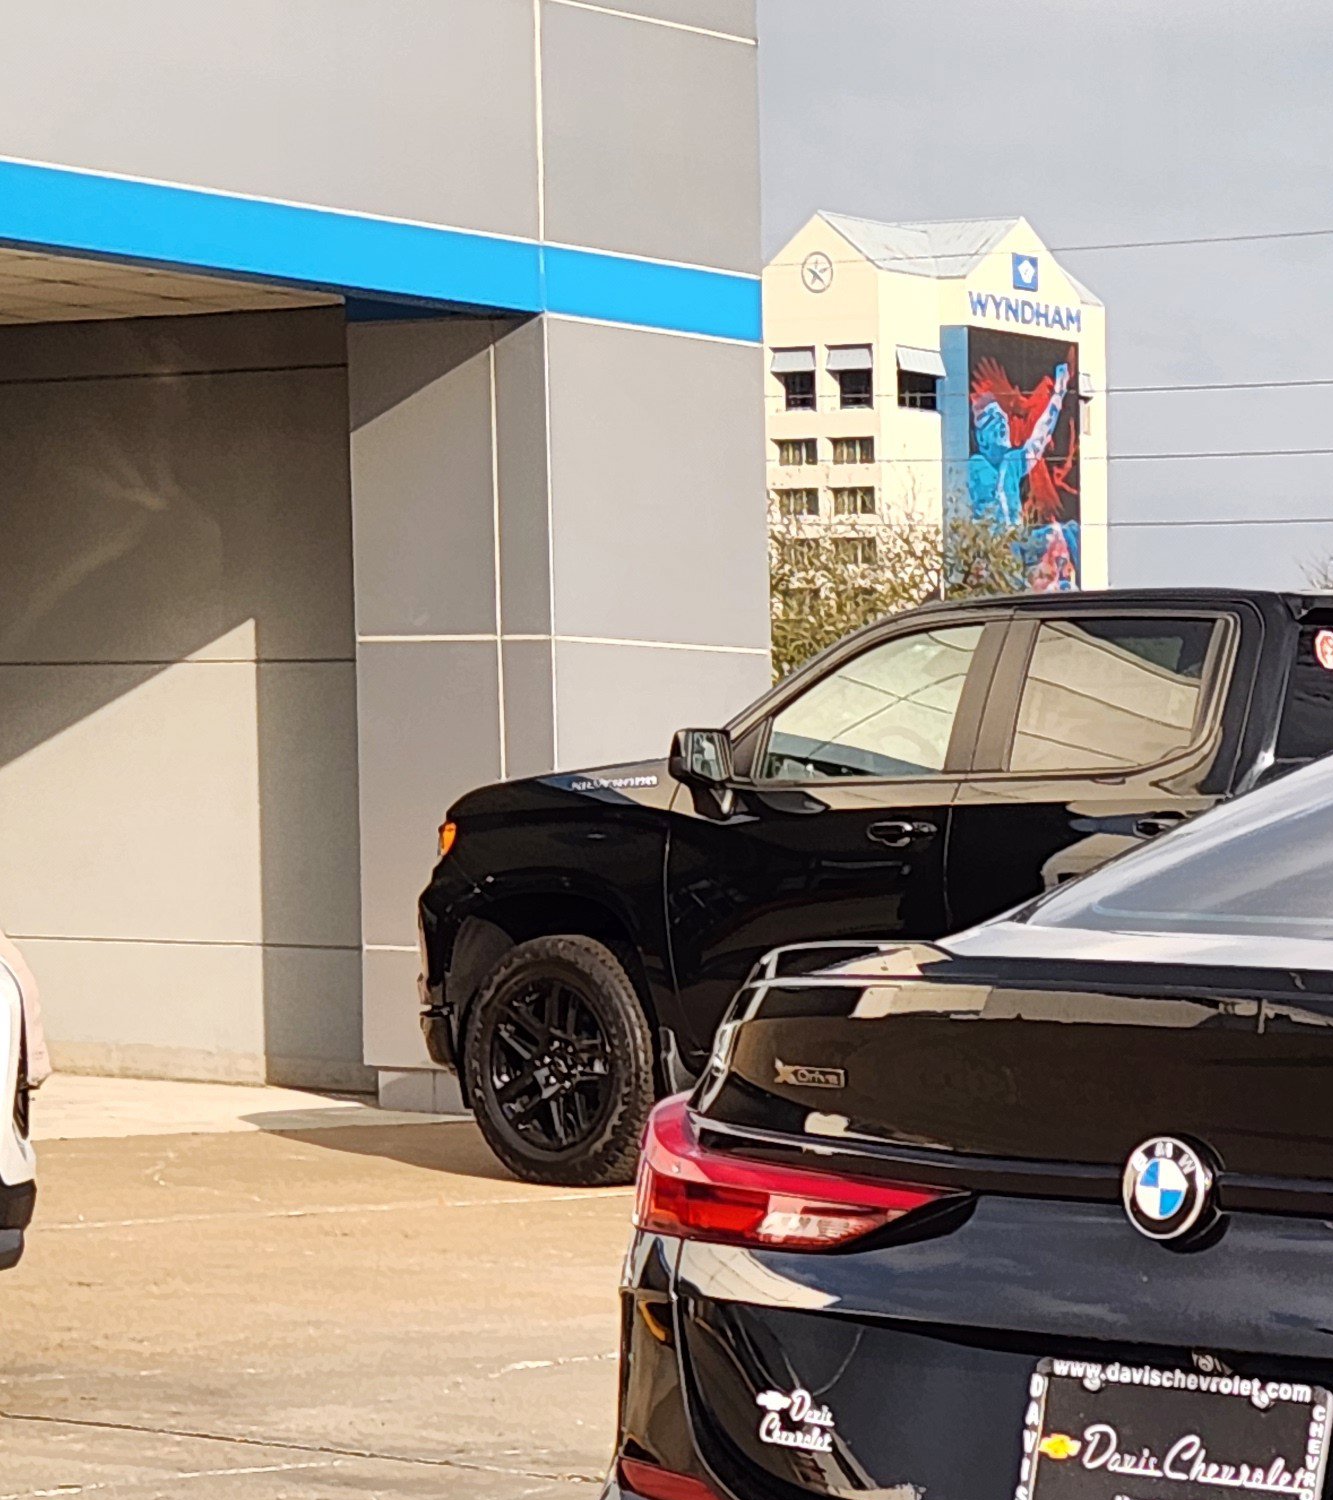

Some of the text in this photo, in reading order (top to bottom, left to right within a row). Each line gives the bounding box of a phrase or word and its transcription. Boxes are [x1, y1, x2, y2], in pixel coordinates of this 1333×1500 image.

[968, 290, 1081, 333] WYNDHAM
[1131, 1141, 1197, 1176] BMW
[1053, 1358, 1312, 1404] www.davischevrolet.com
[1082, 1424, 1305, 1494] Davis Chevrolet
